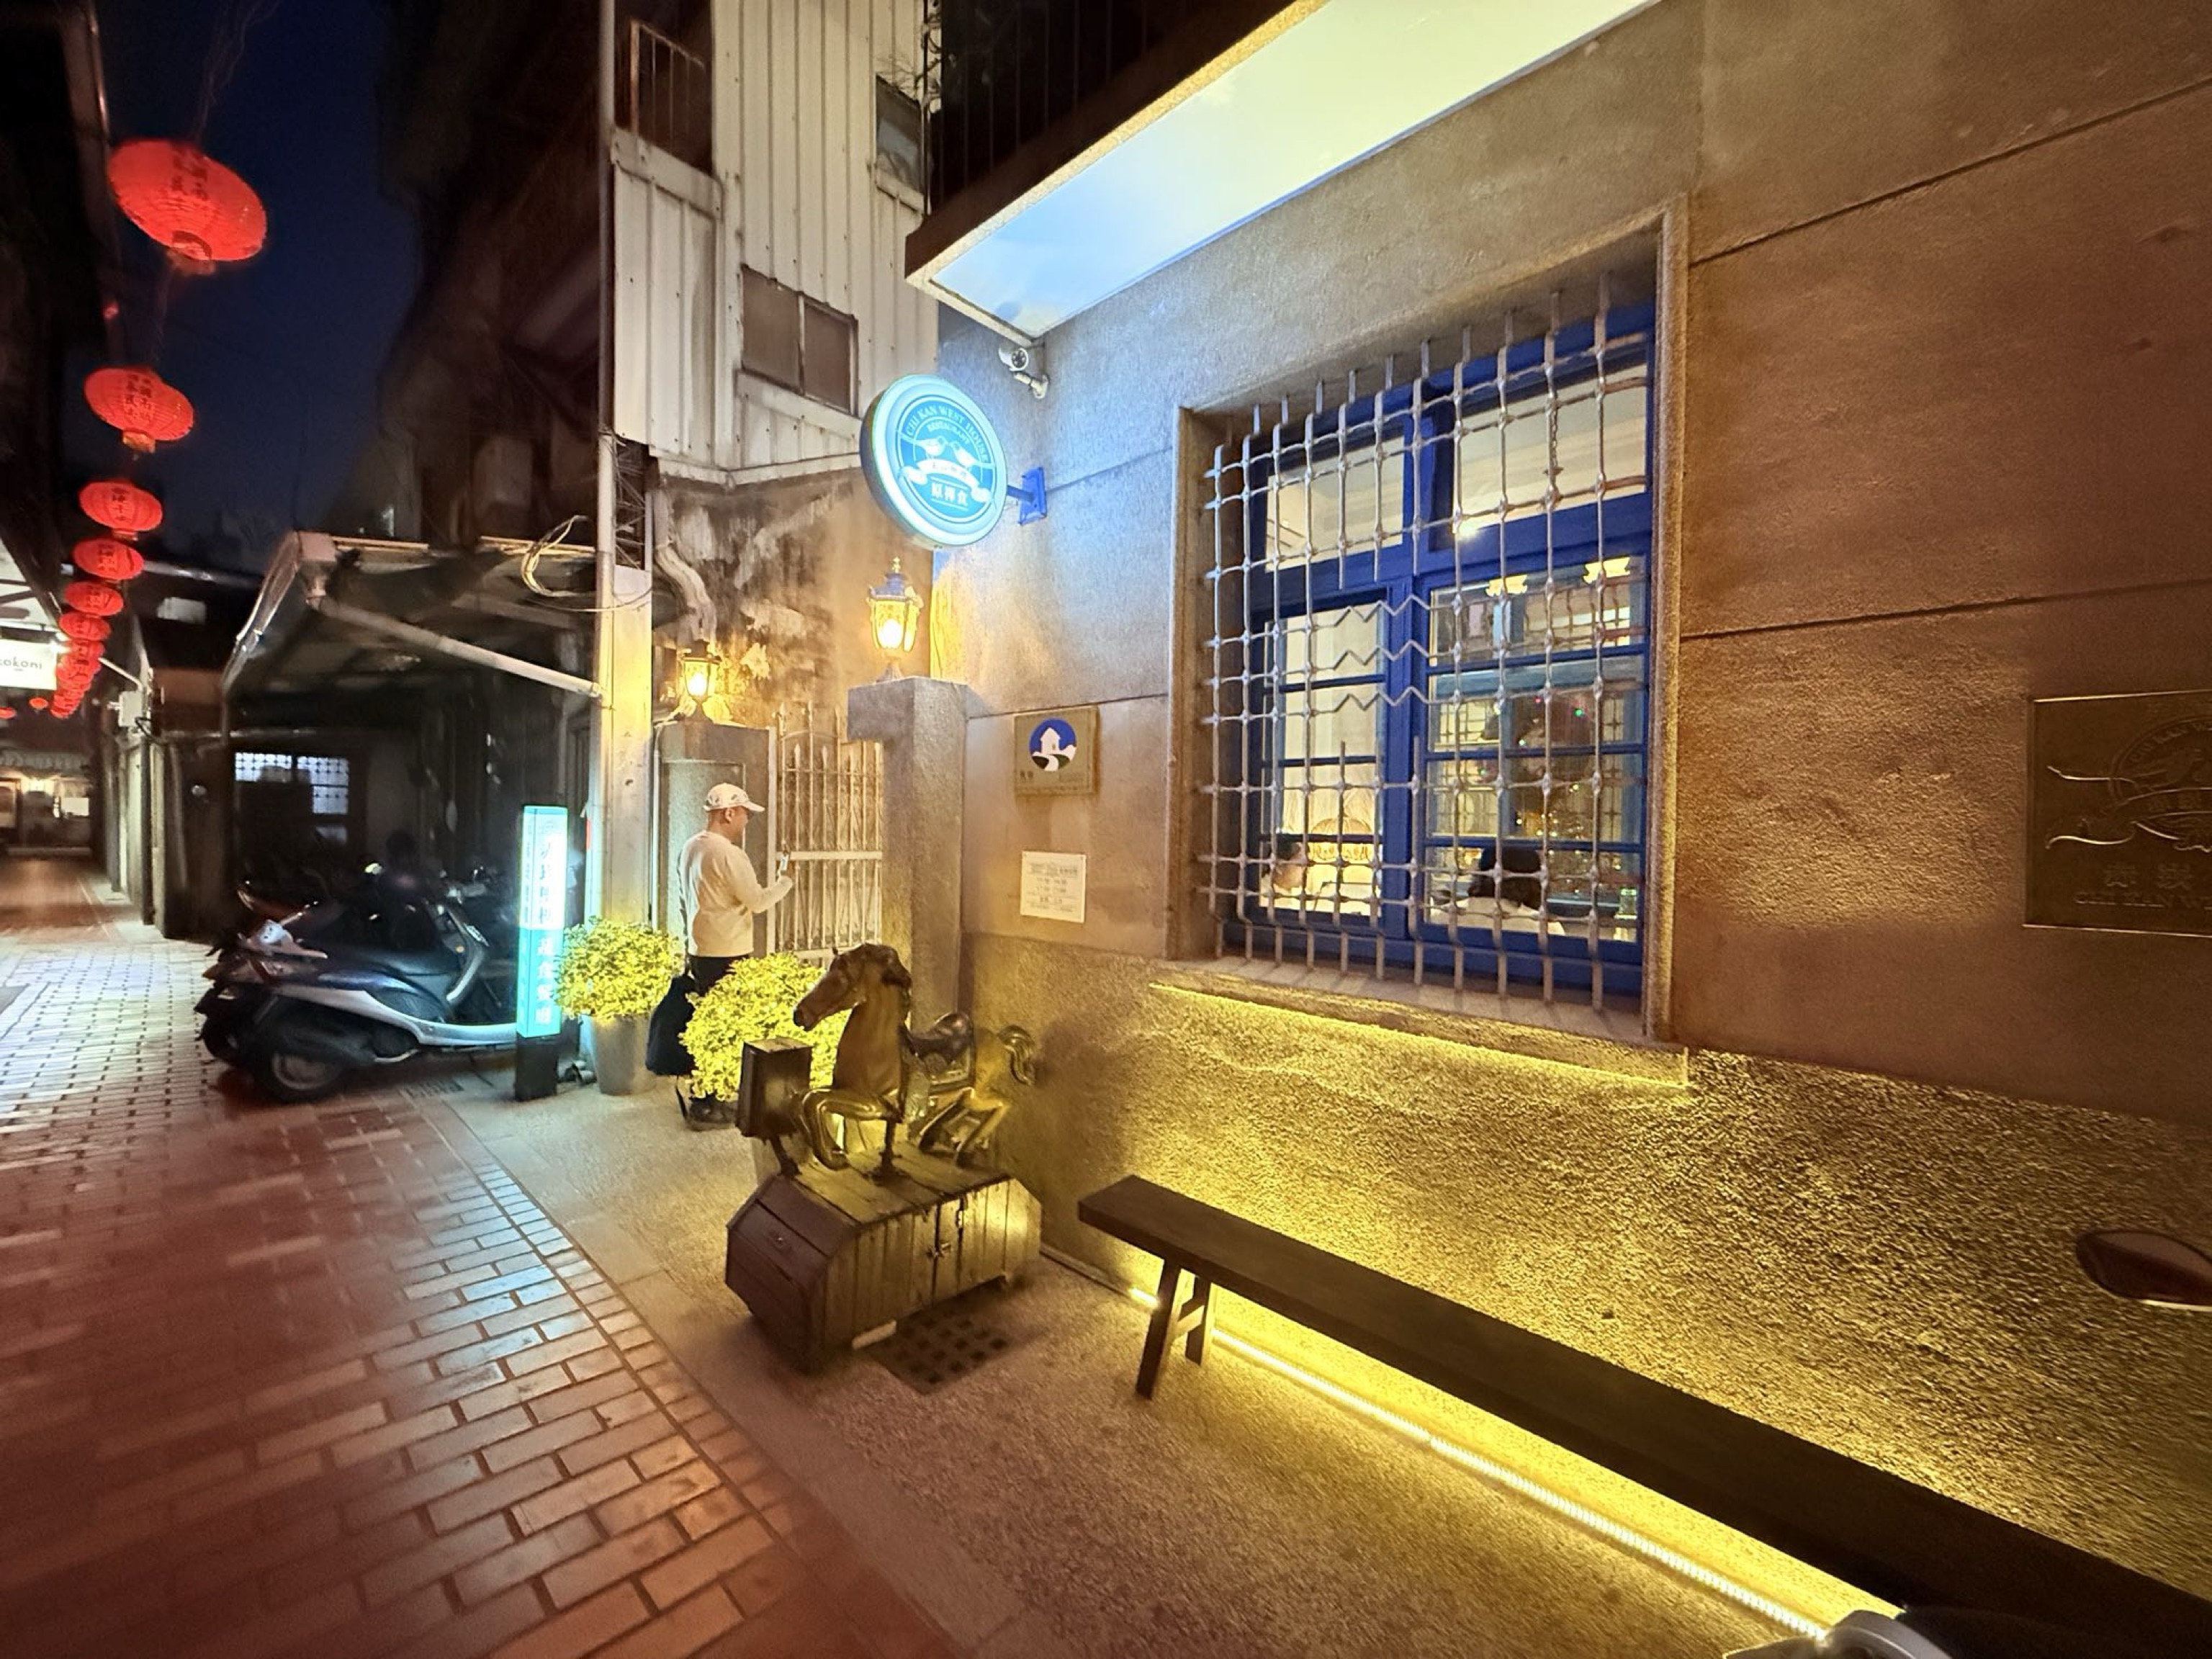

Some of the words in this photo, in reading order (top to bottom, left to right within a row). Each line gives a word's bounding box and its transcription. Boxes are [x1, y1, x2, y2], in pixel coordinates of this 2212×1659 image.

[907, 415, 920, 436] CHI
[917, 405, 938, 419] KAN
[939, 405, 965, 423] WEST
[965, 422, 989, 462] HOUSE
